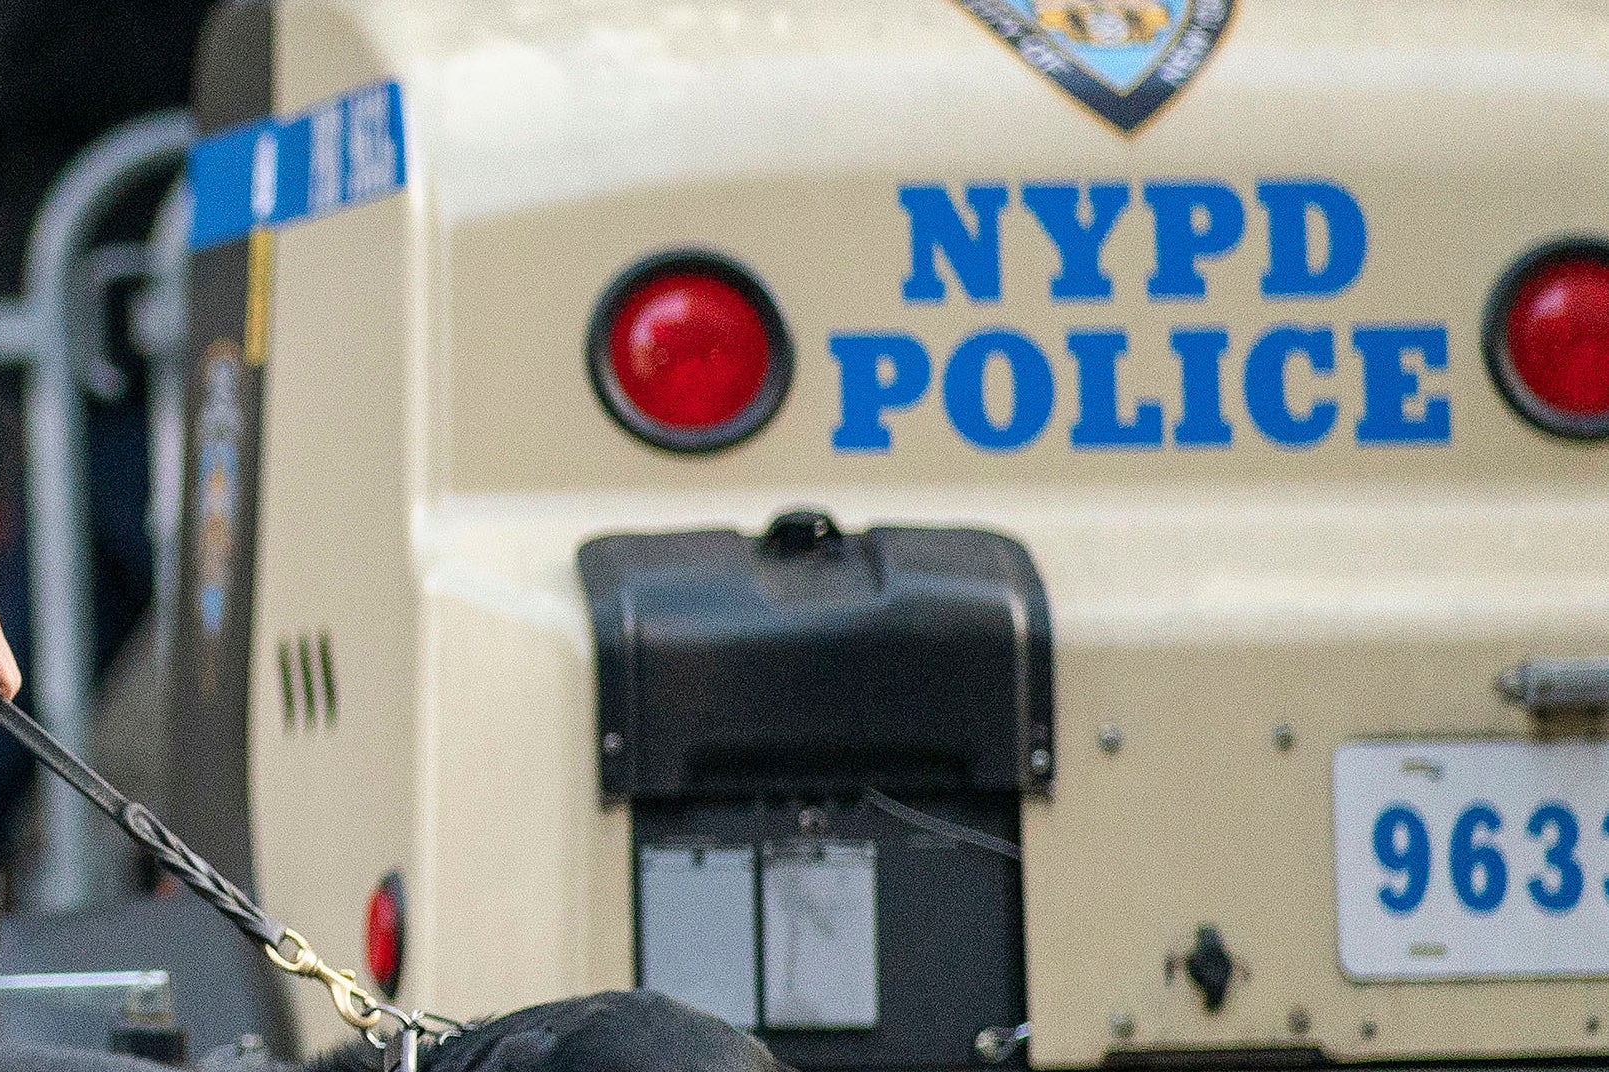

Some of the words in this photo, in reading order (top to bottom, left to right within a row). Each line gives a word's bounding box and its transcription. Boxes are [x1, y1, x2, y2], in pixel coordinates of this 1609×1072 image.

[898, 178, 1369, 303] NYPD
[827, 324, 1452, 450] POLICE
[1372, 803, 1609, 914] 963
